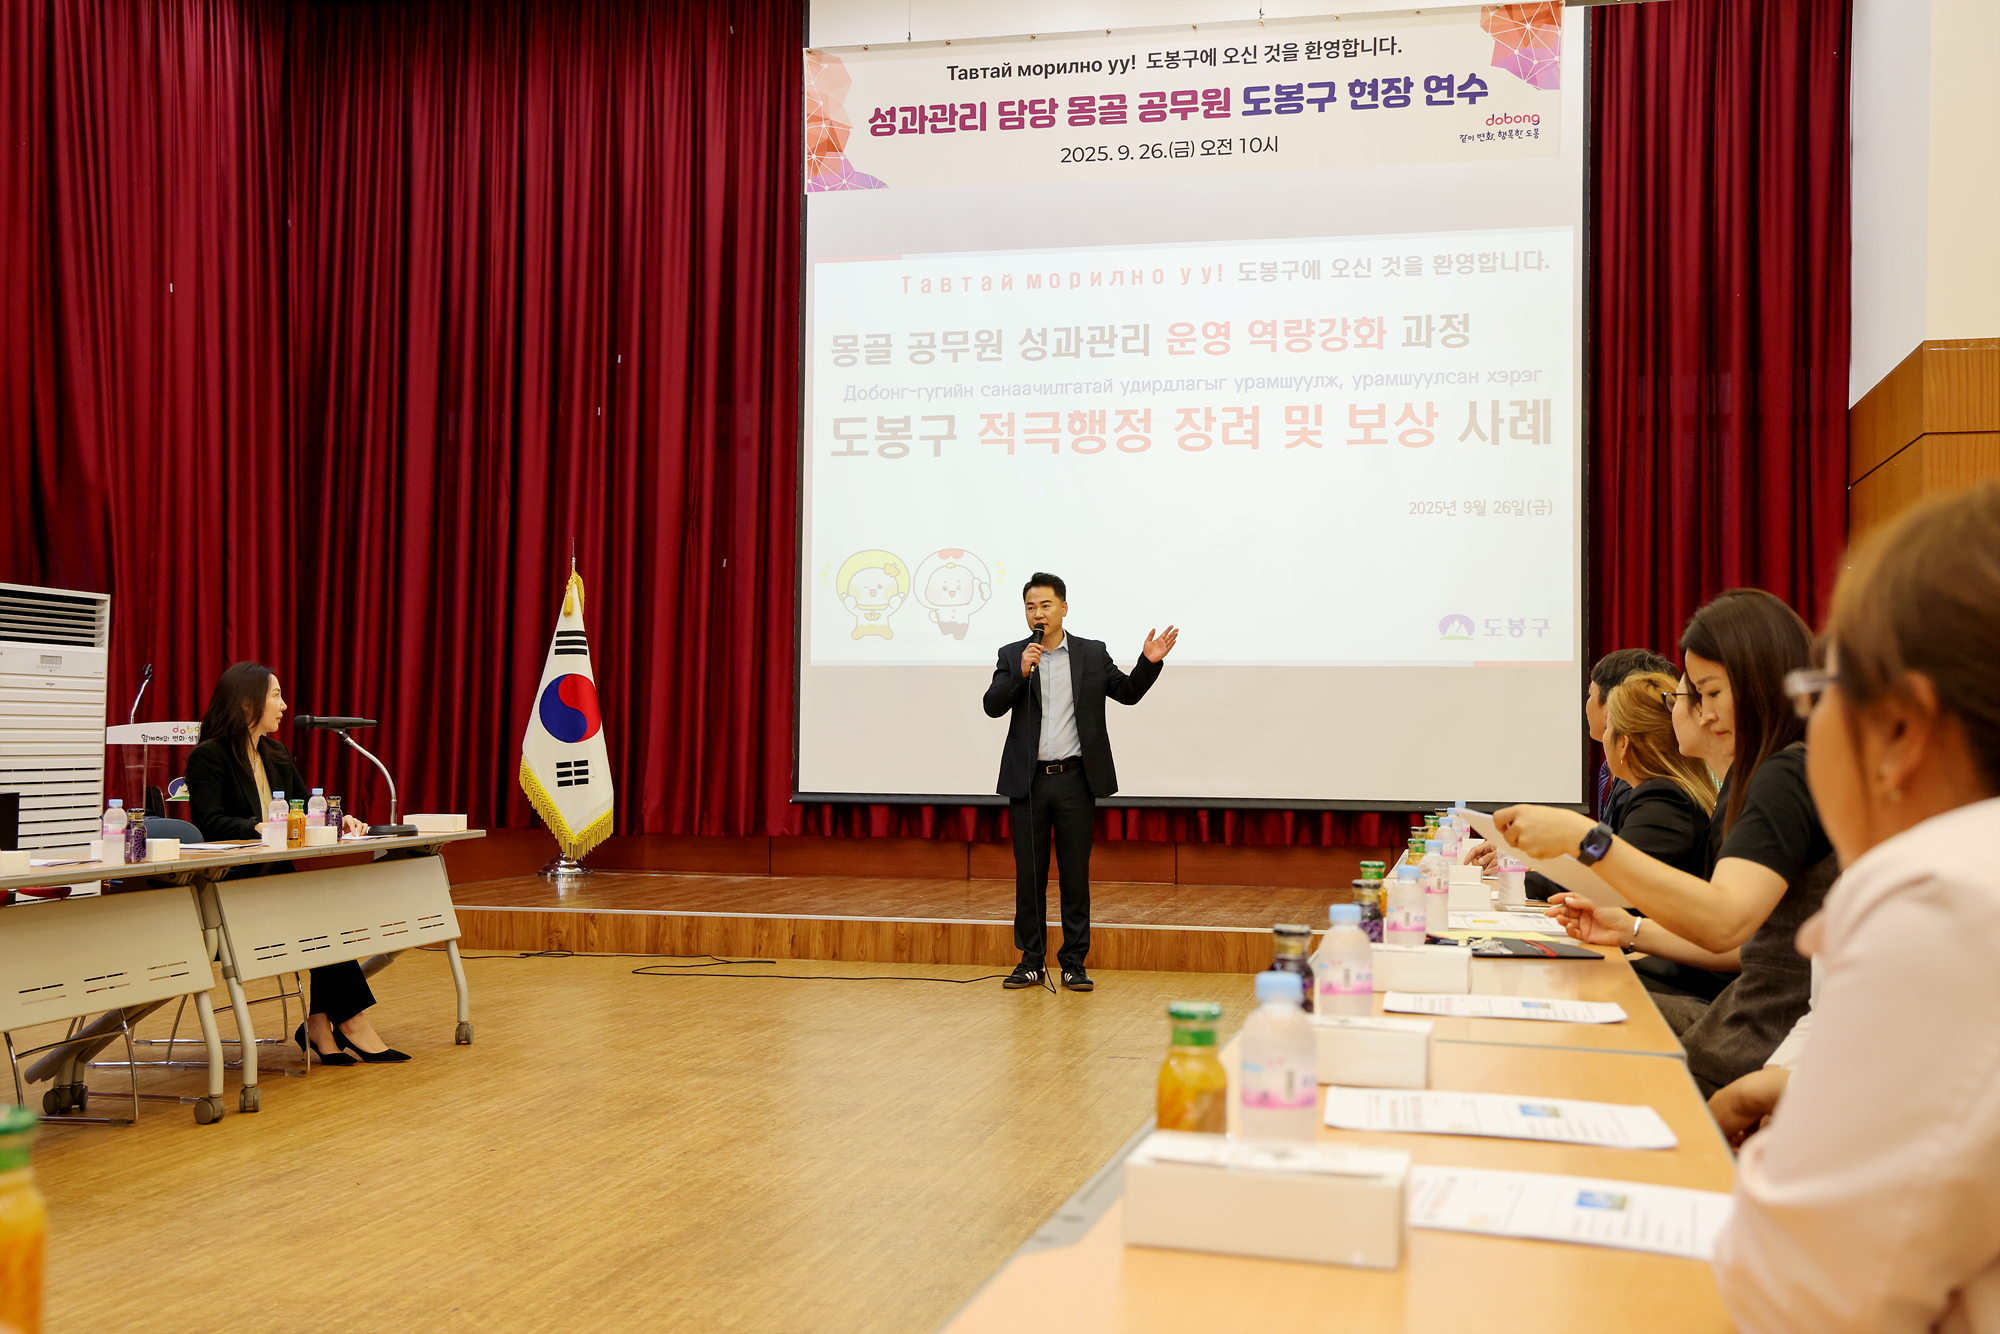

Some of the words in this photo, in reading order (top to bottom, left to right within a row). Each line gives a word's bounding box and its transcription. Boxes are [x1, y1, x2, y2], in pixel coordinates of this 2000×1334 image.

[1147, 48, 1217, 69] 도봉구에
[1223, 45, 1258, 64] 오신
[1264, 43, 1300, 62] 것을
[1305, 36, 1402, 60] 환영합니다.
[947, 63, 1012, 80] Тавтай
[1018, 61, 1103, 79] морилно
[1108, 55, 1136, 75] уу!
[869, 102, 987, 136] 성과관리
[998, 98, 1059, 130] 담당
[1067, 94, 1128, 126] 몽골
[1138, 87, 1232, 122] 공무원
[1242, 82, 1338, 116] 도봉구
[1348, 76, 1415, 110] 현장
[1424, 73, 1489, 106] 연수
[1485, 113, 1540, 126] dobong
[1498, 129, 1523, 140] 행복한
[1526, 128, 1540, 140] 도봉
[1061, 146, 1113, 162] 2025.
[1118, 145, 1134, 160] 9.
[1140, 141, 1195, 159] 26.(금)
[1201, 139, 1233, 155] 오전
[1240, 137, 1278, 153] 10시
[1238, 260, 1321, 282] 도봉구에
[1331, 258, 1372, 278] 오신
[1382, 256, 1424, 277] 것을
[1433, 250, 1550, 275] 환영합니다.
[831, 334, 893, 367] 몽골
[908, 329, 1003, 365] 공무원
[1019, 324, 1150, 361] 성과관리
[1167, 321, 1231, 355] 운영
[1248, 316, 1388, 353] 역량강화
[1402, 313, 1470, 348] 과정
[843, 384, 974, 402] Добонг-гугийн
[981, 379, 1113, 396] санаачилгатай
[1120, 379, 1228, 396] удирдлагыг
[1234, 376, 1344, 393] урамшуулж,
[1352, 372, 1479, 390] урамшуулсан
[1487, 370, 1544, 386] хэрэг
[831, 415, 958, 459] 도봉구
[978, 408, 1152, 455] 적극행정
[1174, 406, 1260, 452] 장려
[1285, 405, 1324, 449] 및
[1347, 402, 1439, 448] 보상
[1458, 399, 1552, 445] 사례
[1409, 500, 1457, 516] 2025년
[1463, 500, 1487, 516] 9월
[1494, 500, 1553, 516] 26일(금)
[1484, 619, 1551, 637] 도봉구
